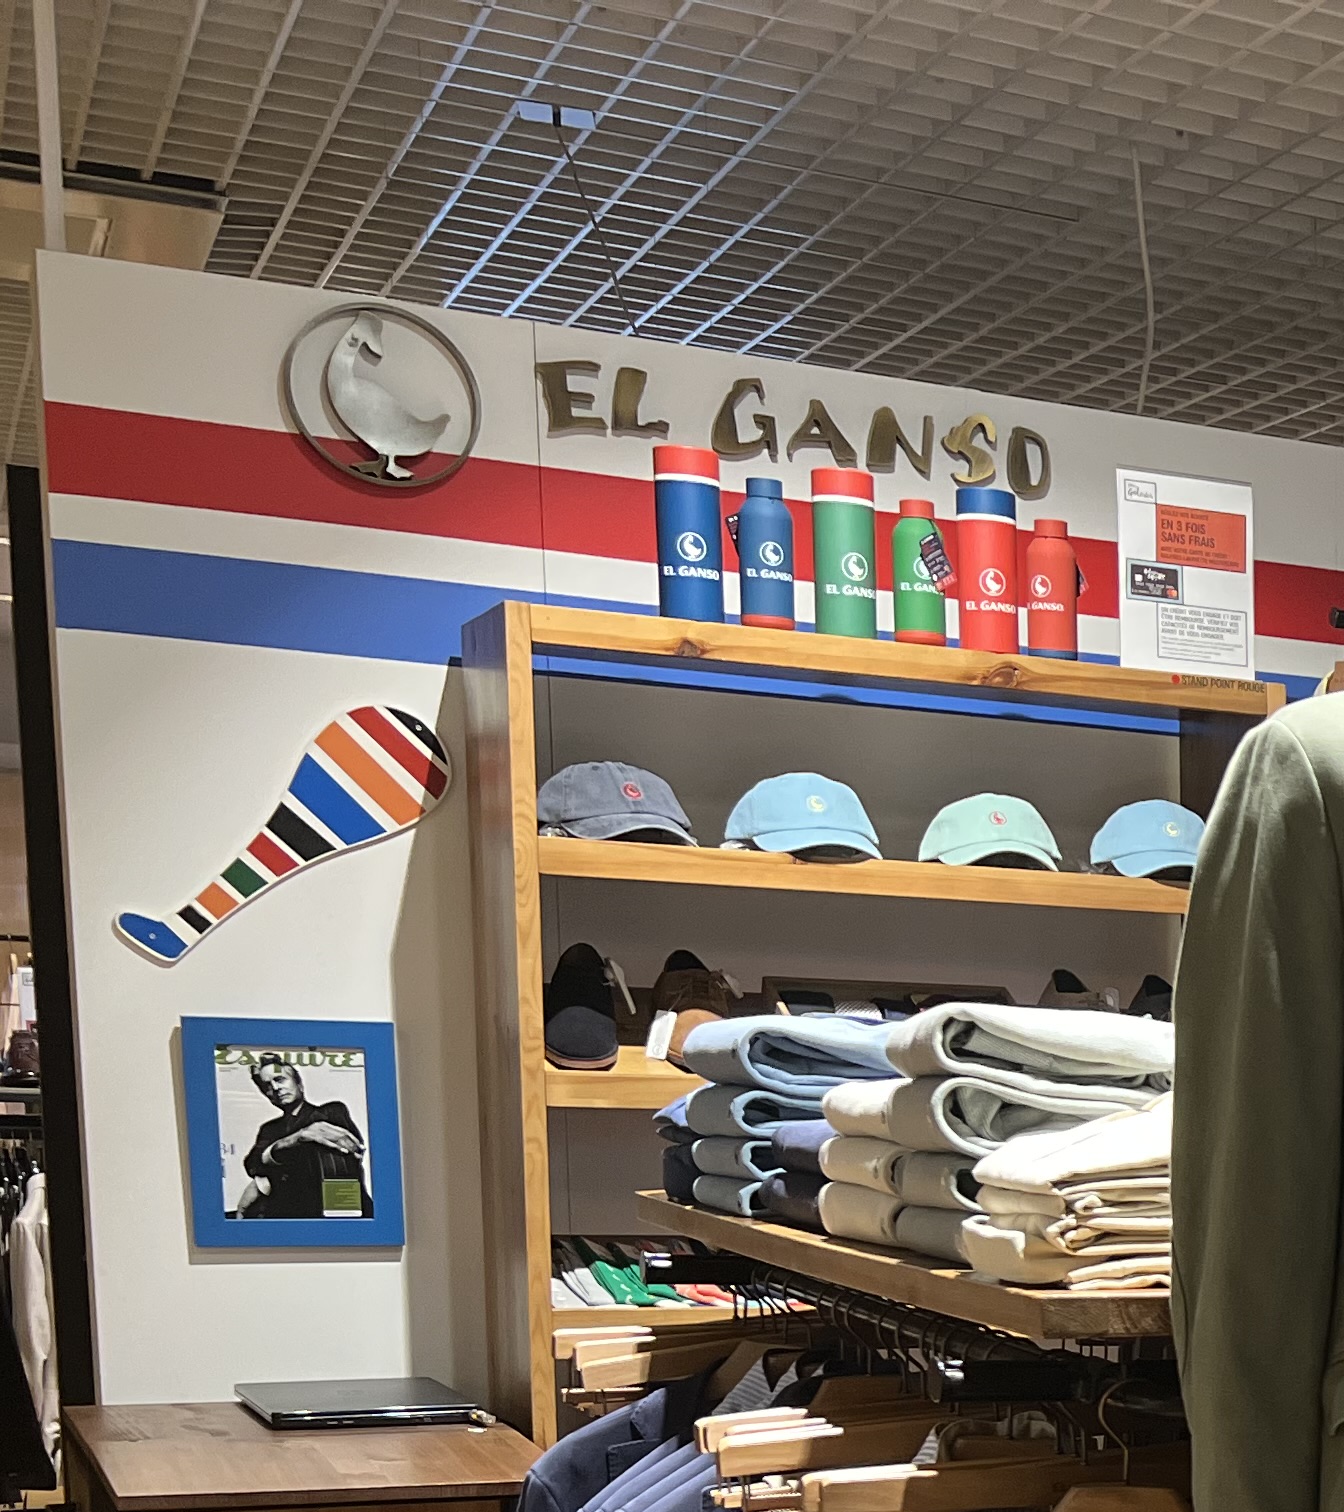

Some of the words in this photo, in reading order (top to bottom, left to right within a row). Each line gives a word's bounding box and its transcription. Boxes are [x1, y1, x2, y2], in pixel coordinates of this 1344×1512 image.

[536, 360, 669, 438] EL
[712, 377, 1051, 499] GANSO
[1161, 519, 1173, 531] EN
[1176, 520, 1183, 531] 3
[1185, 522, 1206, 535] FOIS
[1161, 531, 1186, 544] SANS
[1189, 535, 1216, 548] FRAIS
[664, 565, 676, 576] EL
[678, 565, 720, 581] GANSO
[746, 568, 758, 577] EL
[760, 568, 793, 582] GANSO
[825, 583, 840, 595] EL
[900, 582, 912, 591] EL
[965, 600, 978, 610] EL
[980, 600, 1017, 614] GANSO
[1182, 675, 1208, 687] STAND
[1211, 677, 1235, 689] POINT
[1238, 680, 1265, 693] ROUGE
[214, 1046, 364, 1073] Esuire
